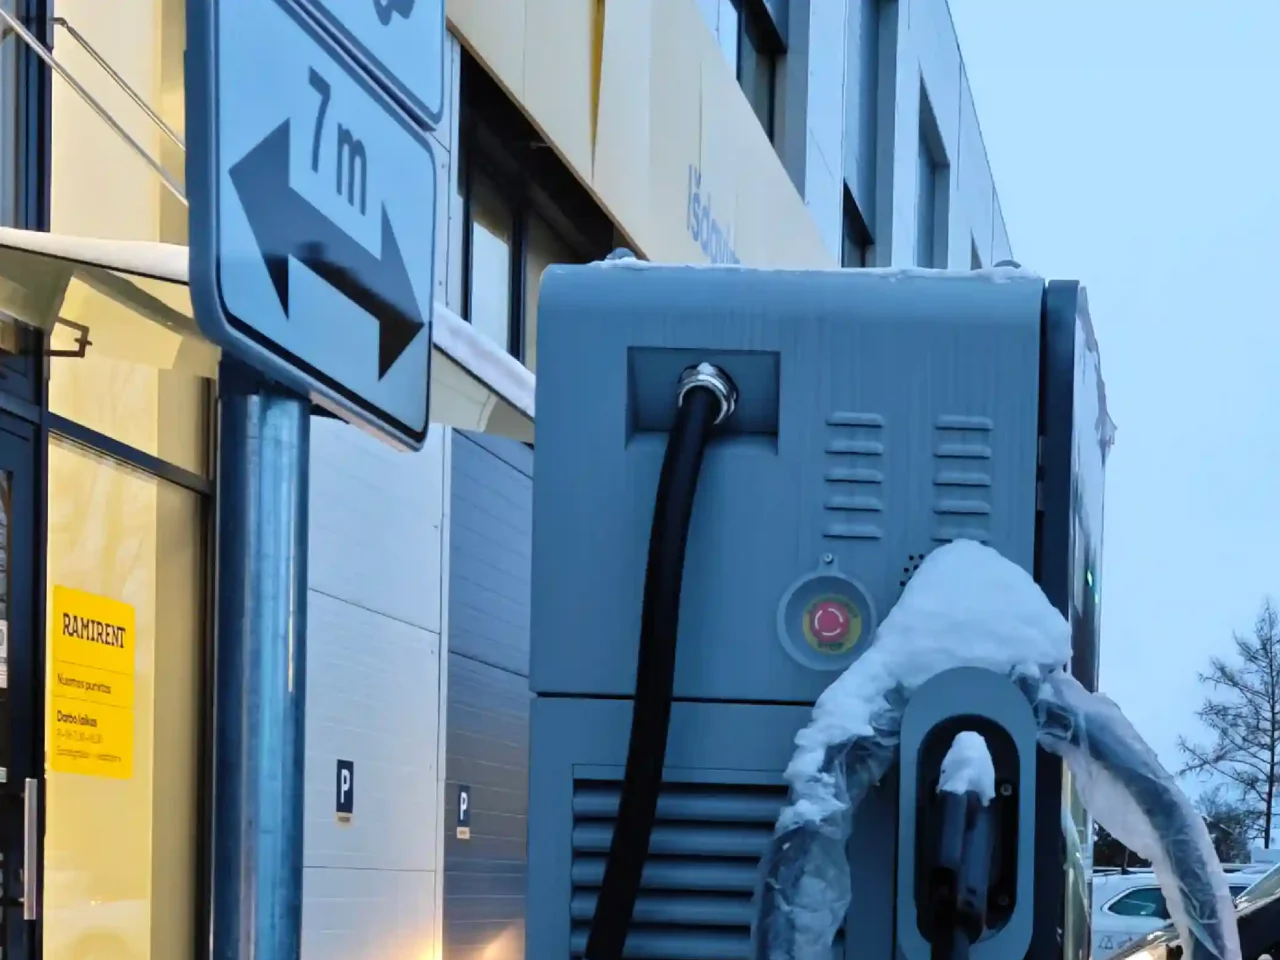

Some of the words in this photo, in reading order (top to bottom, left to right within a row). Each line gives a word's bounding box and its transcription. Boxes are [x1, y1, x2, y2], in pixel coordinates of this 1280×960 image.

[309, 66, 331, 173] 7
[336, 122, 367, 216] m
[63, 612, 126, 649] RAMIRENT
[341, 768, 350, 804] P
[460, 791, 469, 821] P
